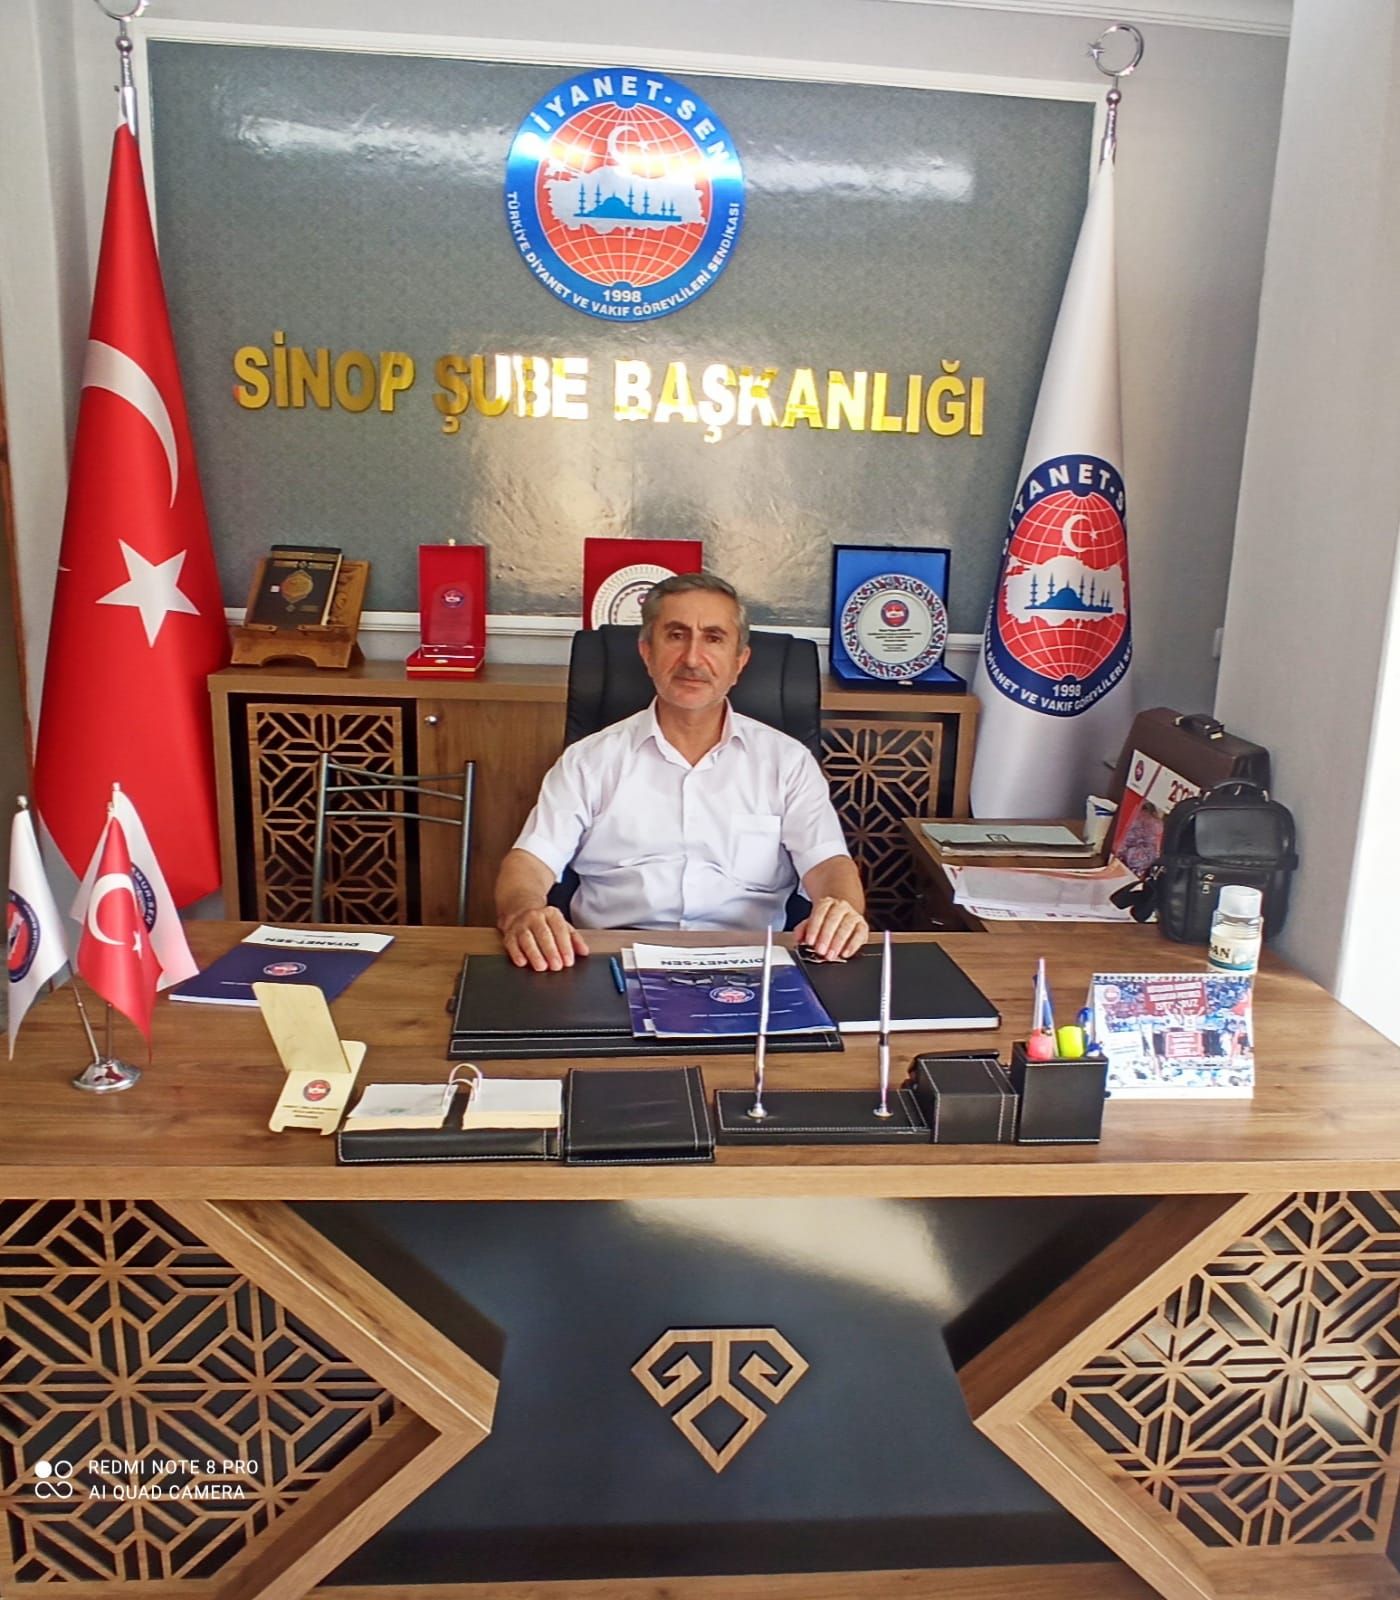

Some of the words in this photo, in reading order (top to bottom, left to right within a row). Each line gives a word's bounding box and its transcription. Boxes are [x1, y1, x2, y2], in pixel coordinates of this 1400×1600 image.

[520, 75, 731, 168] İYANET-SEN
[507, 191, 532, 252] TÜRKİYE
[525, 252, 571, 298] DİYANET
[572, 293, 590, 309] VE
[591, 301, 630, 316] VAKIF
[633, 270, 711, 316] GÖREVLİLERİ
[707, 203, 740, 273] SENDİKASI
[602, 289, 642, 302] 1998
[232, 330, 415, 413] SİNOP
[432, 353, 589, 434] ŞUBE
[614, 359, 985, 443] BAŞKANLIĞI
[1020, 688, 1039, 705] VE
[1041, 697, 1074, 712] VAKIF
[1052, 684, 1081, 697] 1998
